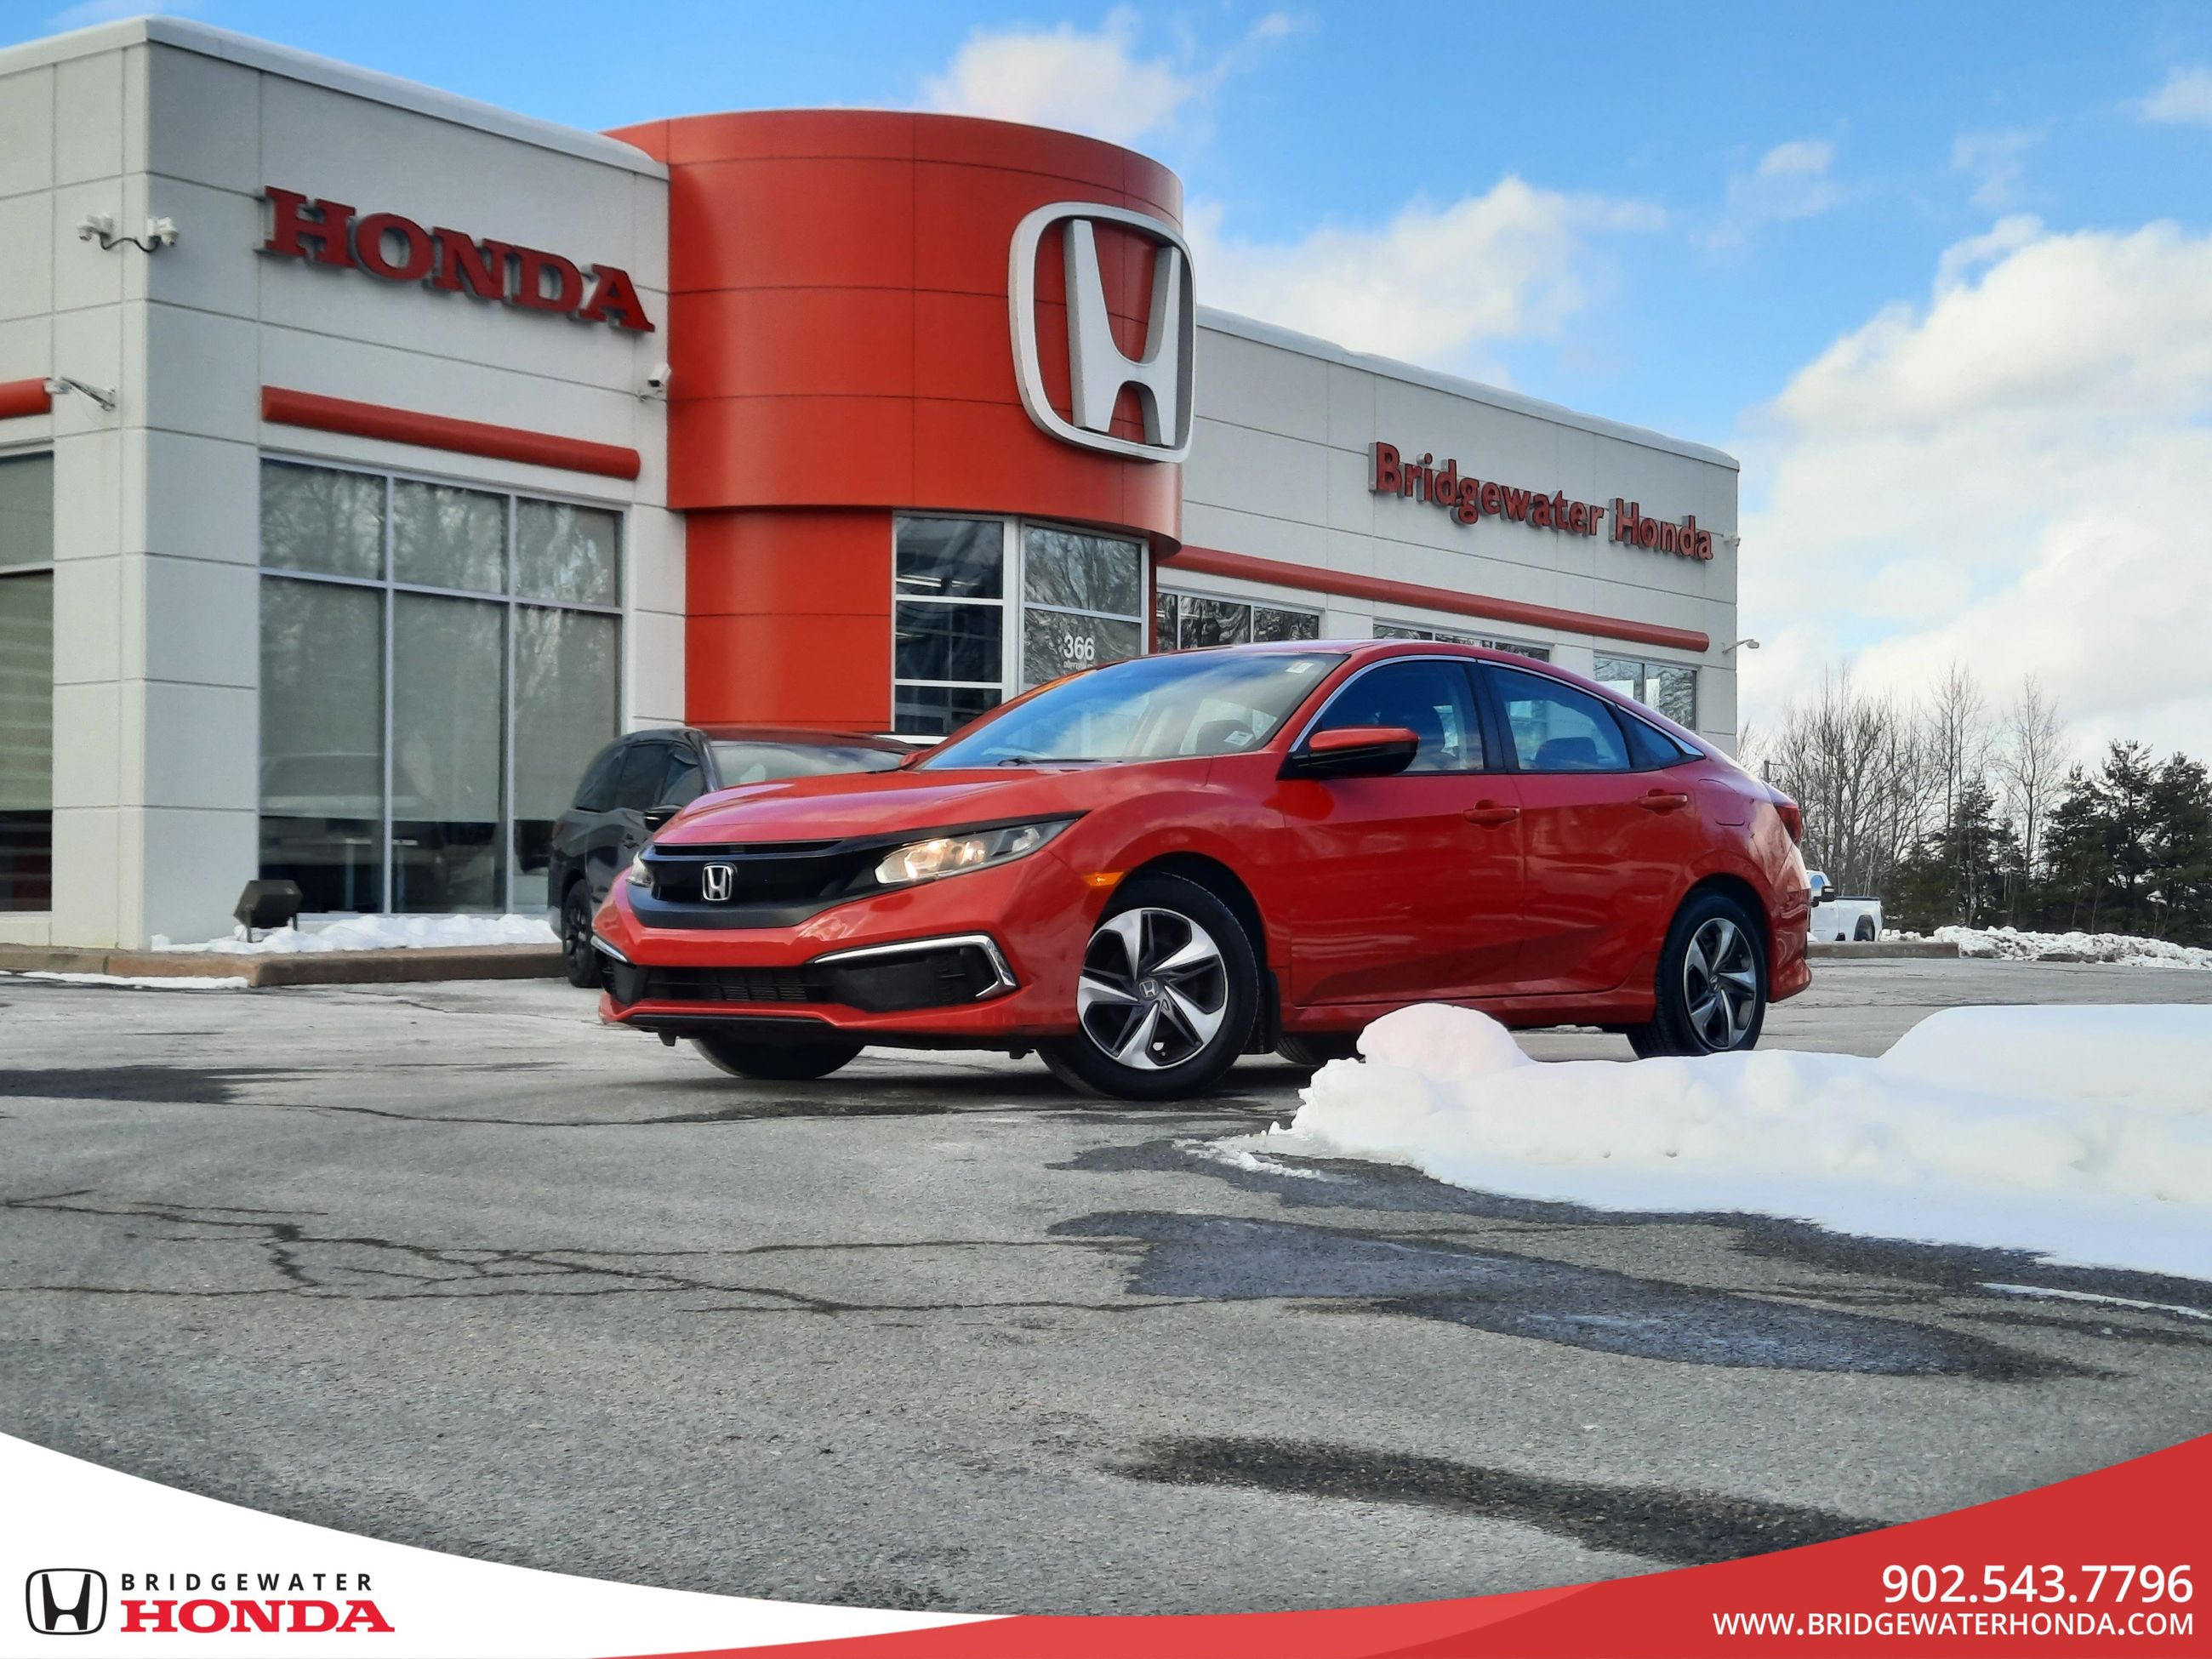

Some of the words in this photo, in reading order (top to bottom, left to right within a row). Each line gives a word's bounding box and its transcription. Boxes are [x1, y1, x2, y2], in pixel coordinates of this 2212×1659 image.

[262, 185, 655, 333] HONDA
[1369, 441, 1605, 537] Bridgewater
[1610, 497, 1714, 561] Honda
[1063, 634, 1095, 661] 366
